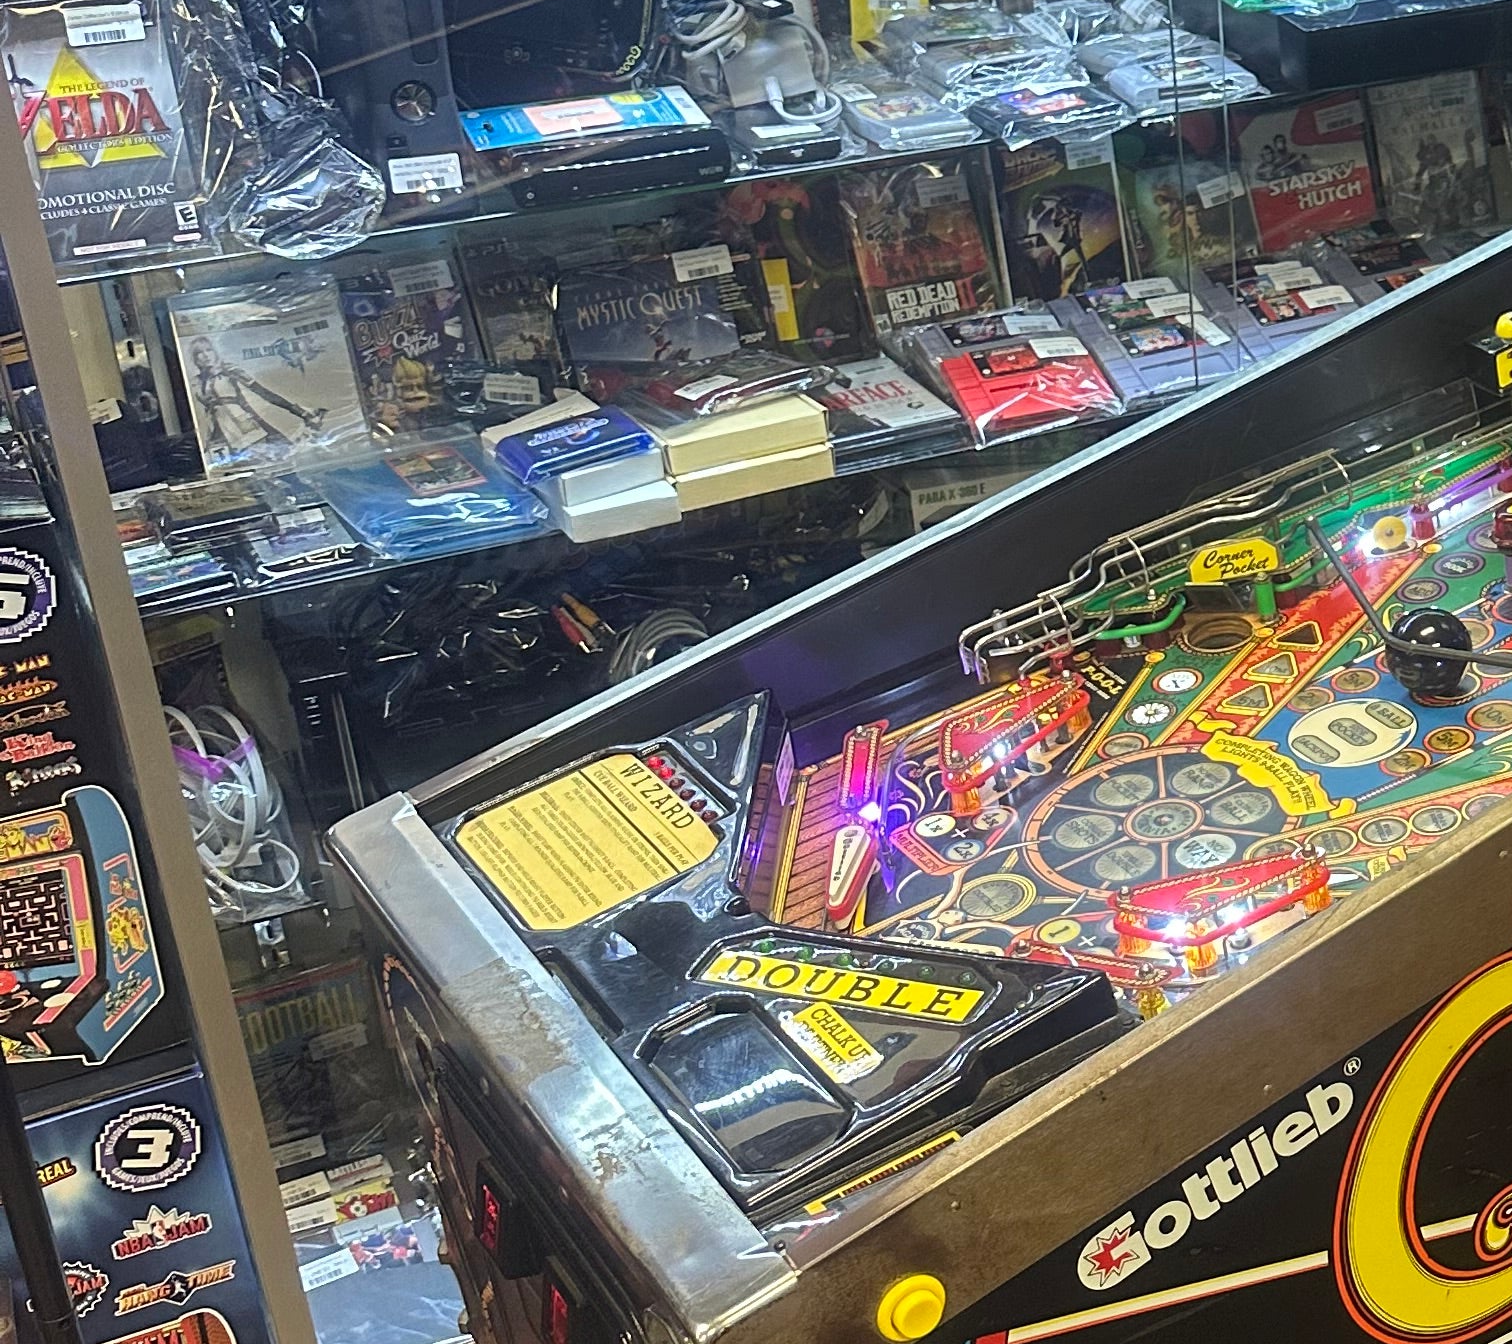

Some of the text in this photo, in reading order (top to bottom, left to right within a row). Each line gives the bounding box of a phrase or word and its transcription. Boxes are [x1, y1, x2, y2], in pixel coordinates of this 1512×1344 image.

[60, 76, 146, 95] THE LEGEND OF
[127, 132, 174, 148] EDITION
[138, 181, 177, 196] DISC
[1269, 160, 1355, 198] STARSKY
[1299, 181, 1362, 211] HUTCH
[178, 205, 196, 223] E
[576, 285, 702, 331] MYSTIC QUEST
[886, 288, 918, 310] RED
[917, 280, 957, 305] DEAD
[890, 298, 960, 325] REDEMPTION
[392, 326, 428, 350] Quiz
[402, 331, 441, 358] World
[1203, 547, 1255, 570] Corner
[1220, 557, 1269, 579] Pocket
[1221, 745, 1262, 769] LIGHTS
[1215, 738, 1318, 811] COMPLETING WAGON WHEEL
[619, 762, 696, 831] WIZARD
[1182, 833, 1219, 866] WAY
[727, 955, 965, 1017] DOUBLE
[240, 982, 360, 1055] OOTBALL
[810, 1008, 857, 1049] CHALK
[121, 1129, 174, 1169] 3
[36, 1157, 73, 1185] REAL
[1076, 1081, 1355, 1292] Gottlieb
[116, 1215, 207, 1258] NBA JAM
[73, 1278, 104, 1296] JAM
[118, 1264, 231, 1310] HANG TIME
